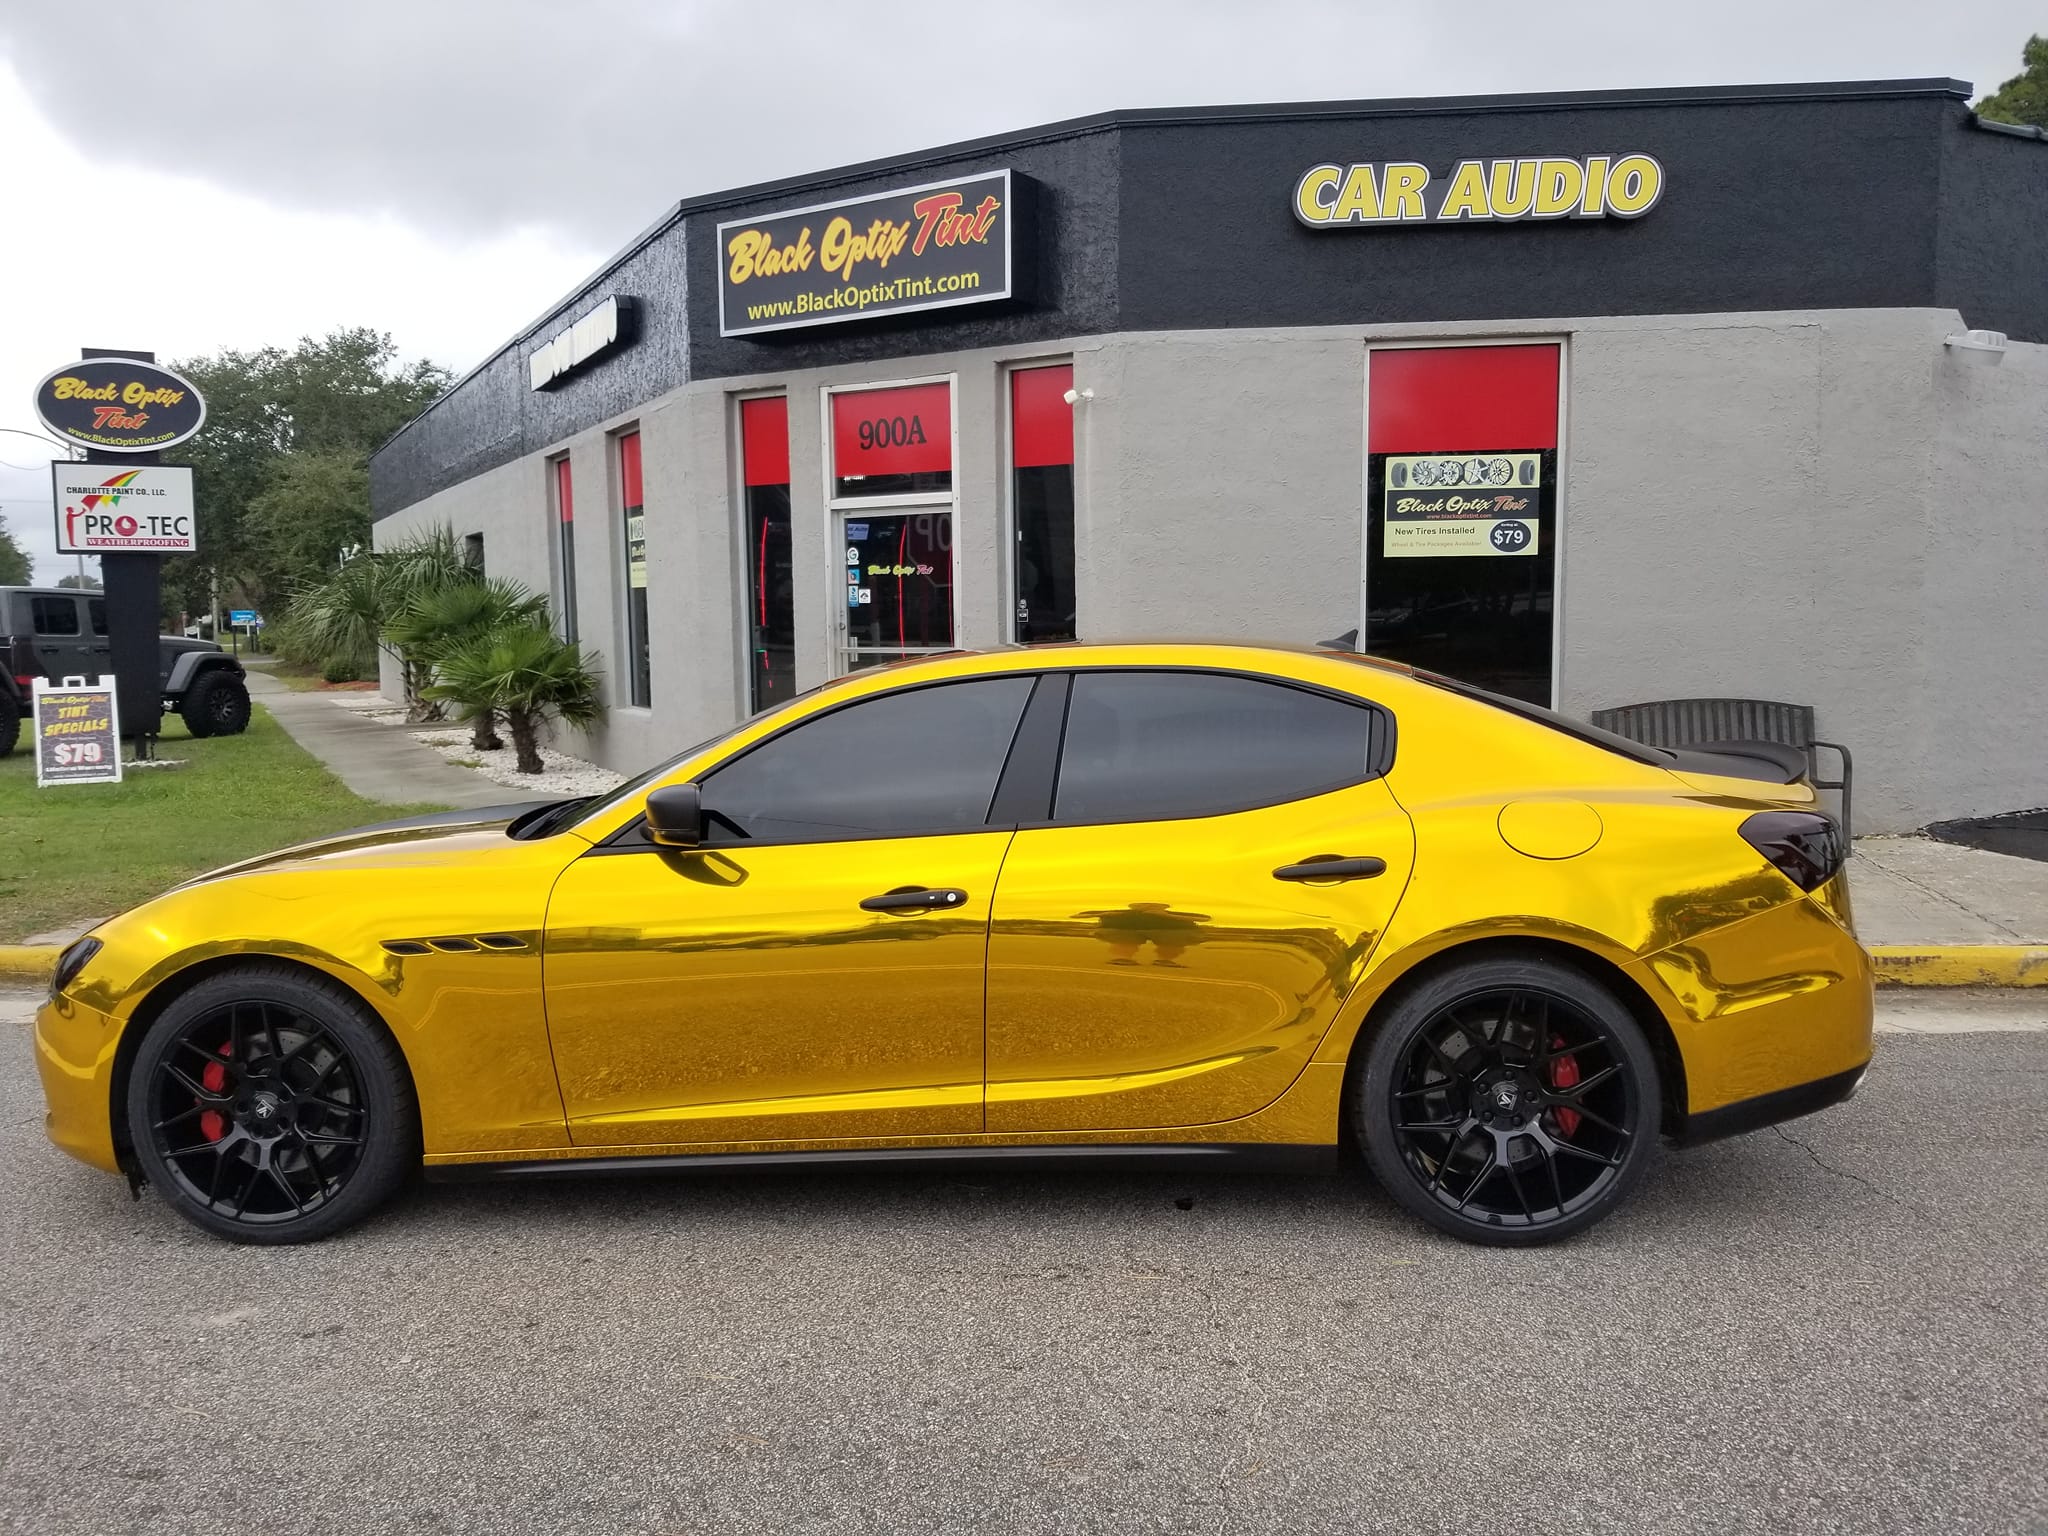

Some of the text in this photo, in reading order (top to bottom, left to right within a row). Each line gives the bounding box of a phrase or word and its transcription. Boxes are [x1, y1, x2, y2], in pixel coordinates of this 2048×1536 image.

[1297, 154, 1661, 223] CAR AUDIO
[728, 192, 1000, 284] Black Optix Tint
[747, 271, 979, 320] www.BlackOptixTint.com
[53, 377, 184, 409] Black Optix
[92, 406, 150, 430] Tint
[67, 427, 176, 447] www.BlackOptixTint.com
[858, 415, 927, 450] 900A
[66, 486, 110, 494] CHARLOTTE
[1396, 496, 1530, 514] Black Optix Tint
[85, 515, 188, 537] PRO-TEC
[1415, 527, 1437, 535] Tires
[87, 538, 188, 546] WEATHERPROOFING
[1494, 529, 1524, 546] $79
[58, 704, 90, 719] TINT
[44, 718, 109, 737] SPECIALS
[54, 743, 102, 766] $79
